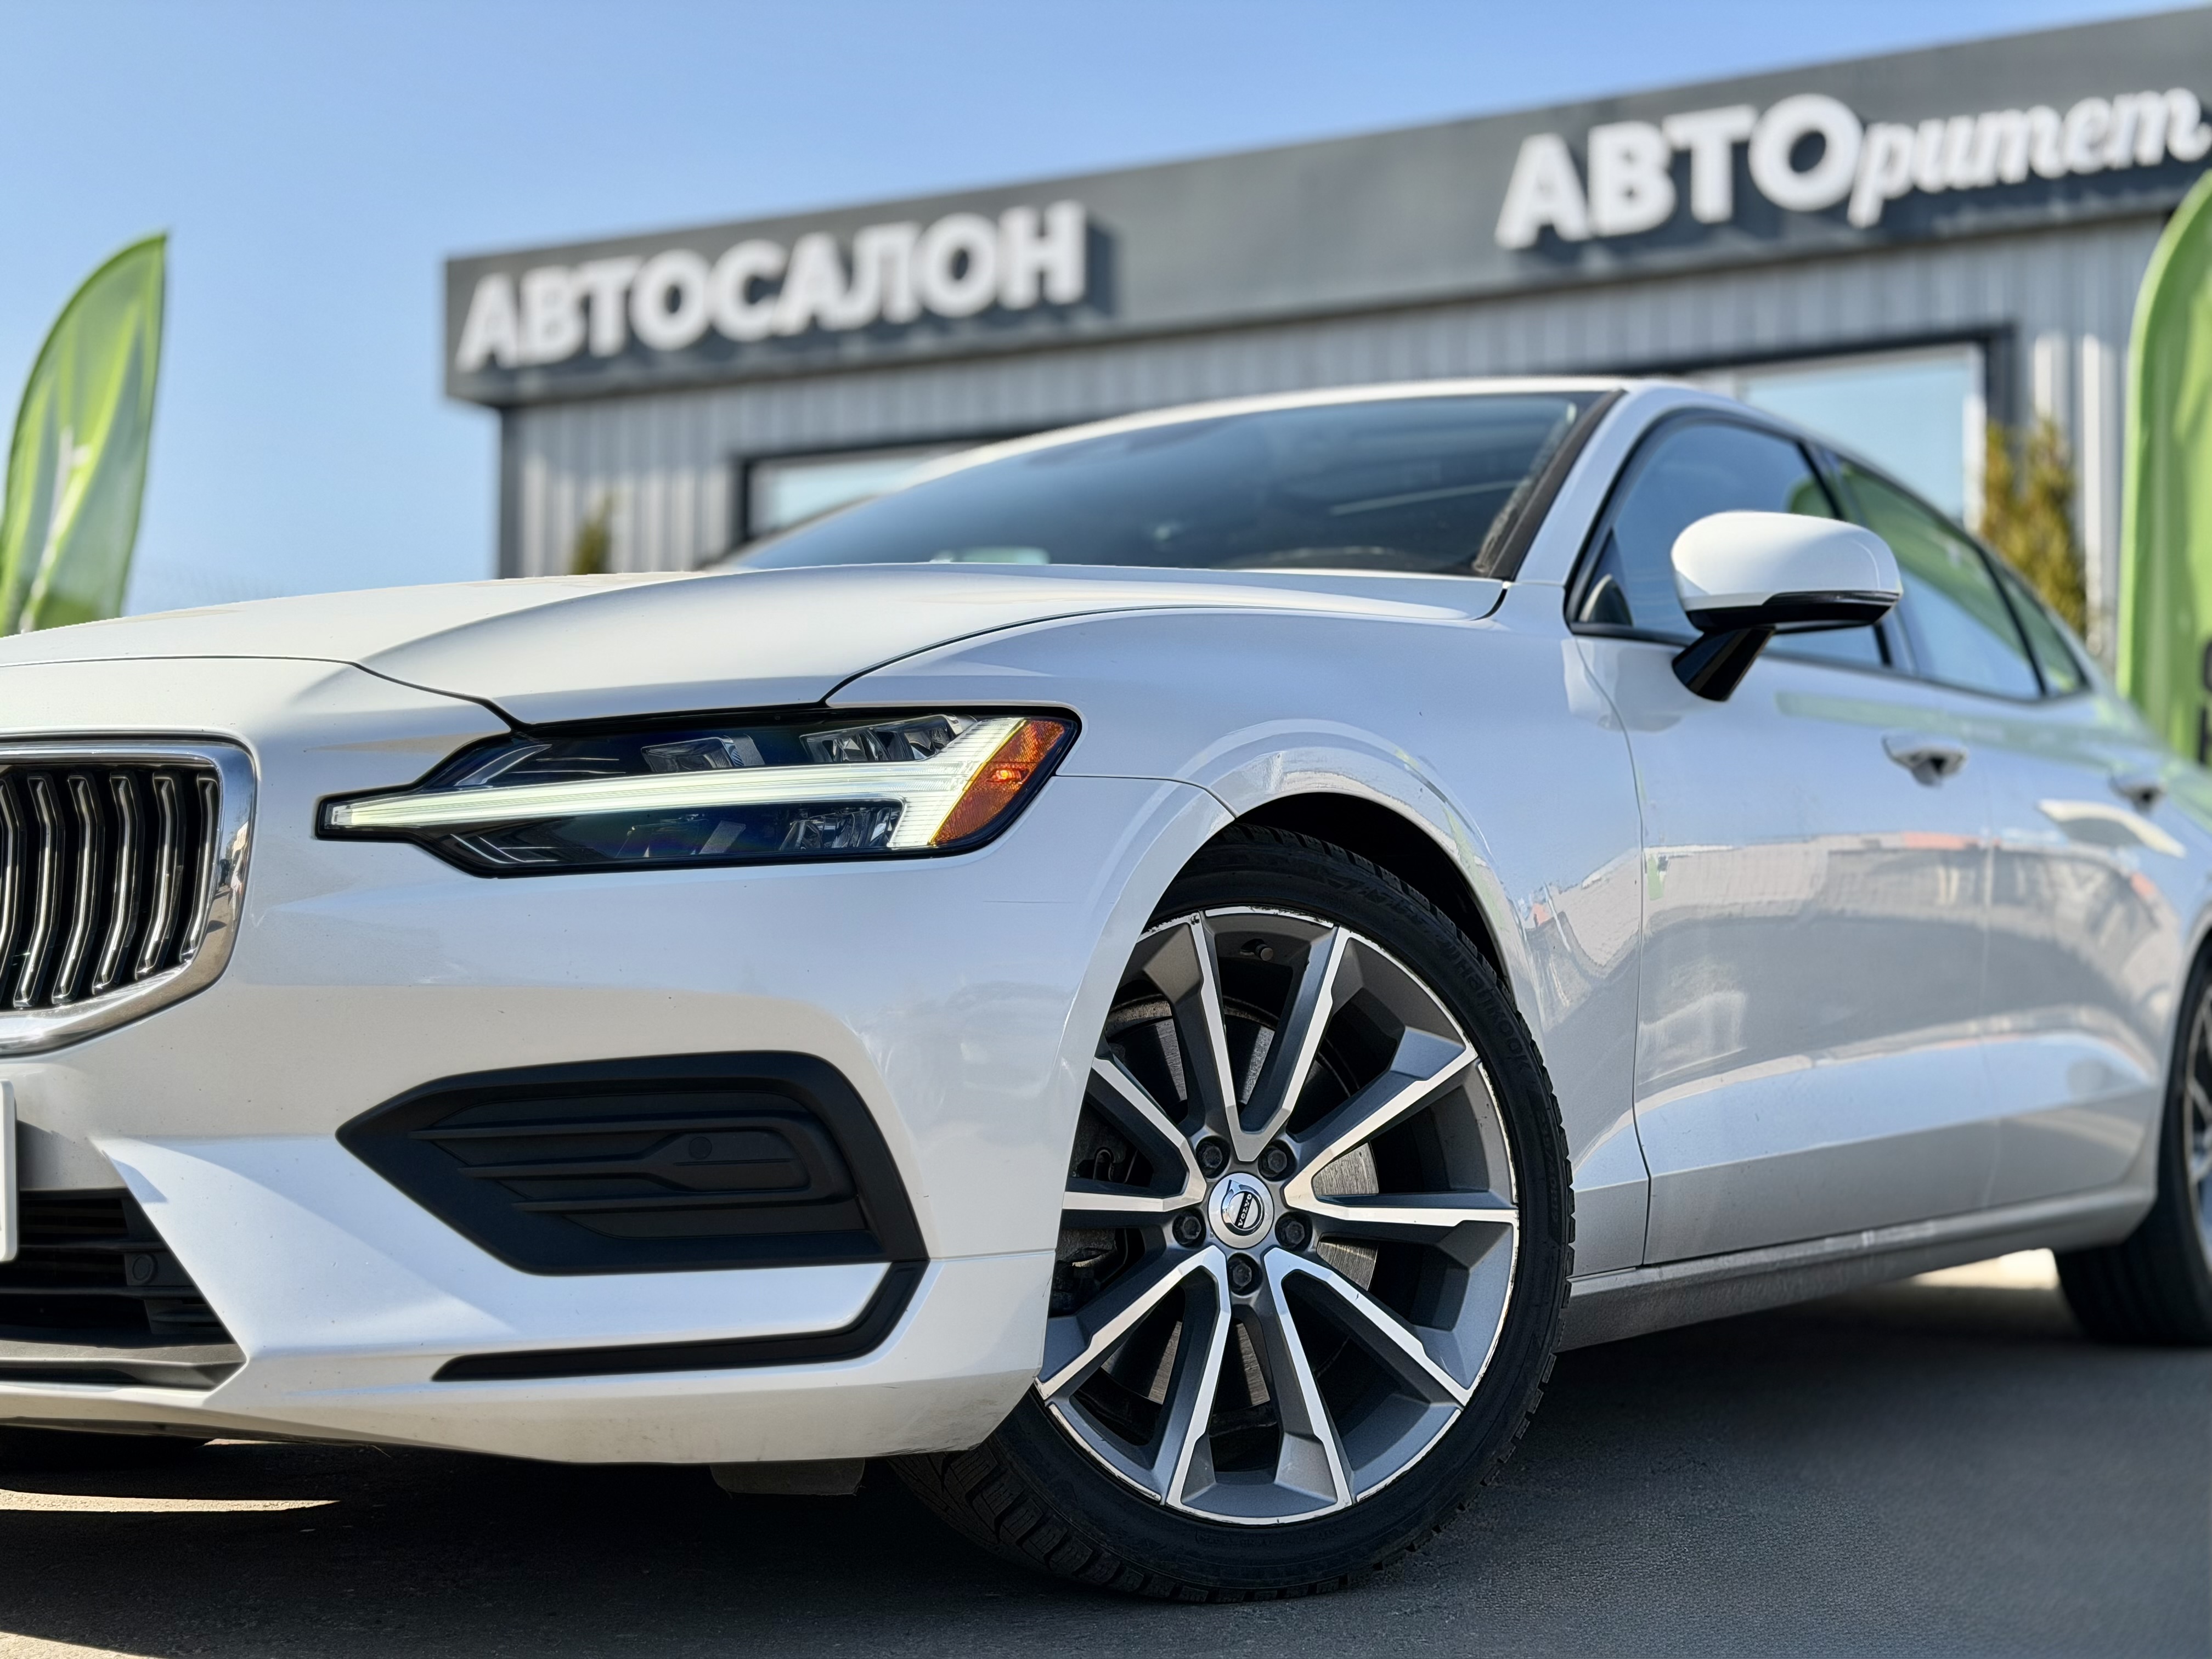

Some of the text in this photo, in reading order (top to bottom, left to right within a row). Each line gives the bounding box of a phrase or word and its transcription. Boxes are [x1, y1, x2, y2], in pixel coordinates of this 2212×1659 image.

[455, 87, 2212, 372] АВТОСАЛОН АВТОритет
[1238, 1194, 1252, 1226] VOLVO
